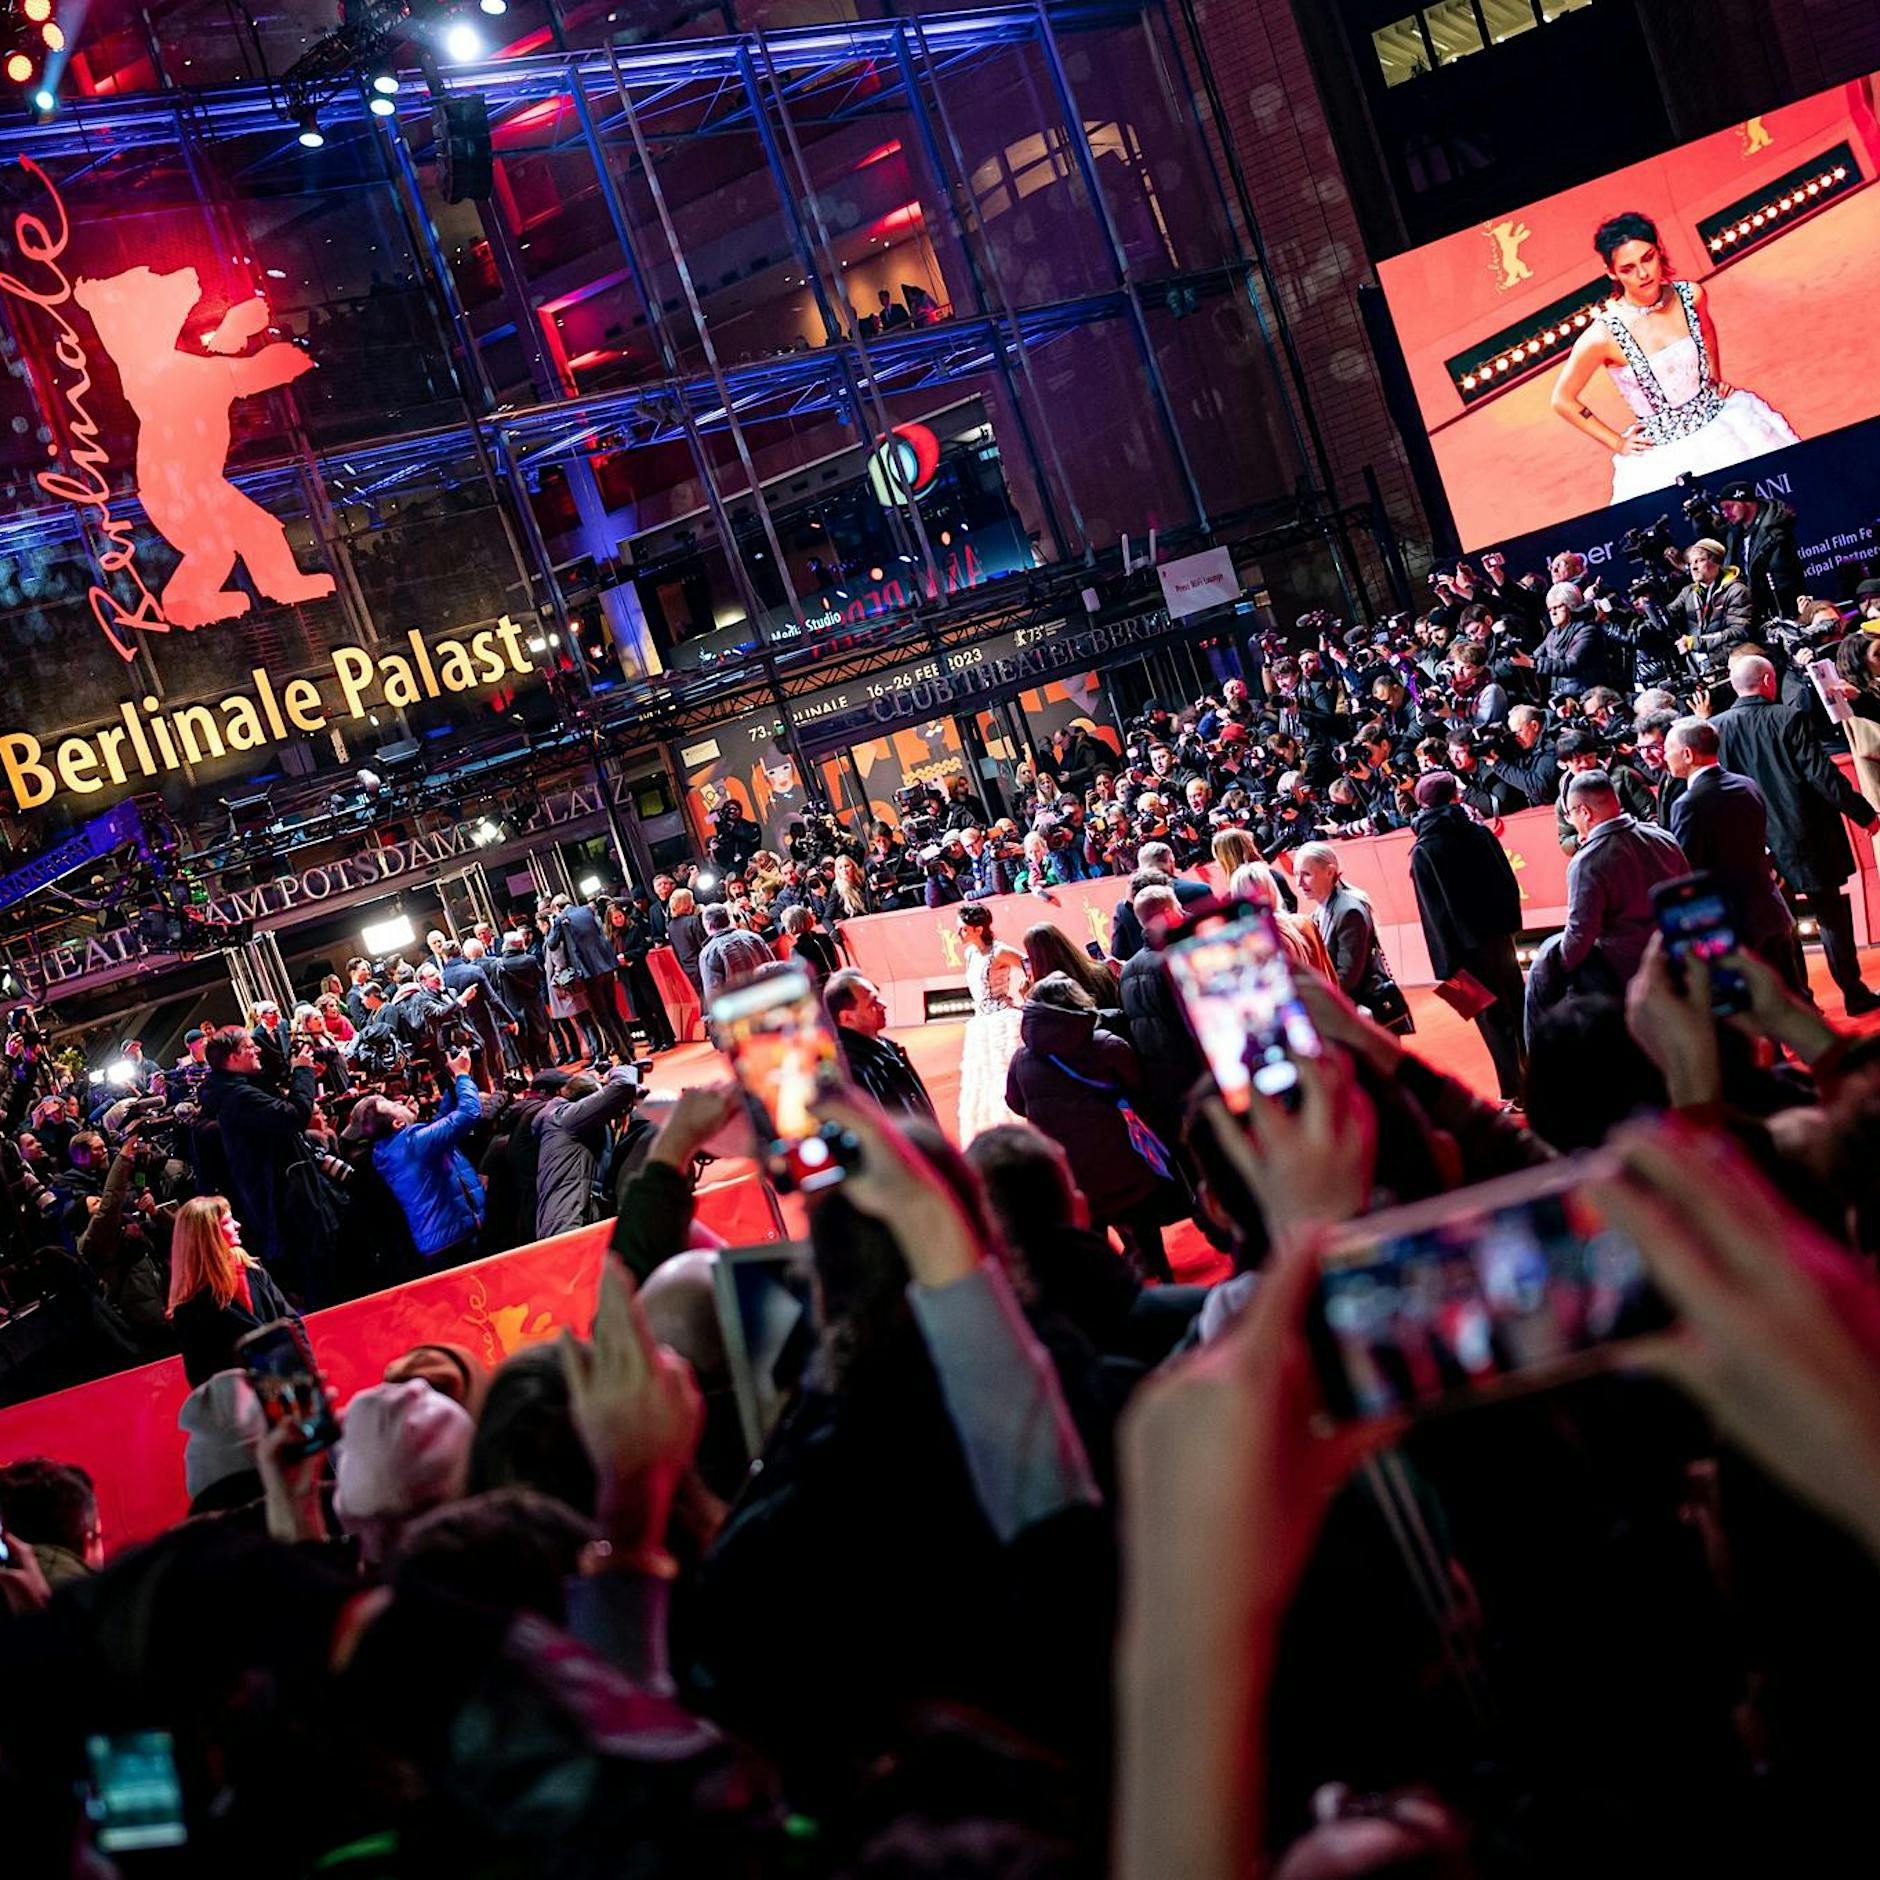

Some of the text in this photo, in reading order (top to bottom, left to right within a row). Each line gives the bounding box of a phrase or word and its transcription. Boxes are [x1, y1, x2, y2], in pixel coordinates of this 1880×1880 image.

[0, 154, 170, 662] Berlinale
[1755, 473, 1793, 500] ANI
[1797, 527, 1873, 560] tional Film Fe
[1803, 557, 1834, 578] cipal
[805, 610, 842, 632] Studio
[0, 613, 535, 811] Berlinale Palast
[873, 675, 954, 722] CLUB
[748, 724, 772, 742] 73.
[204, 885, 274, 925] AM
[275, 820, 488, 911] POTSDAM
